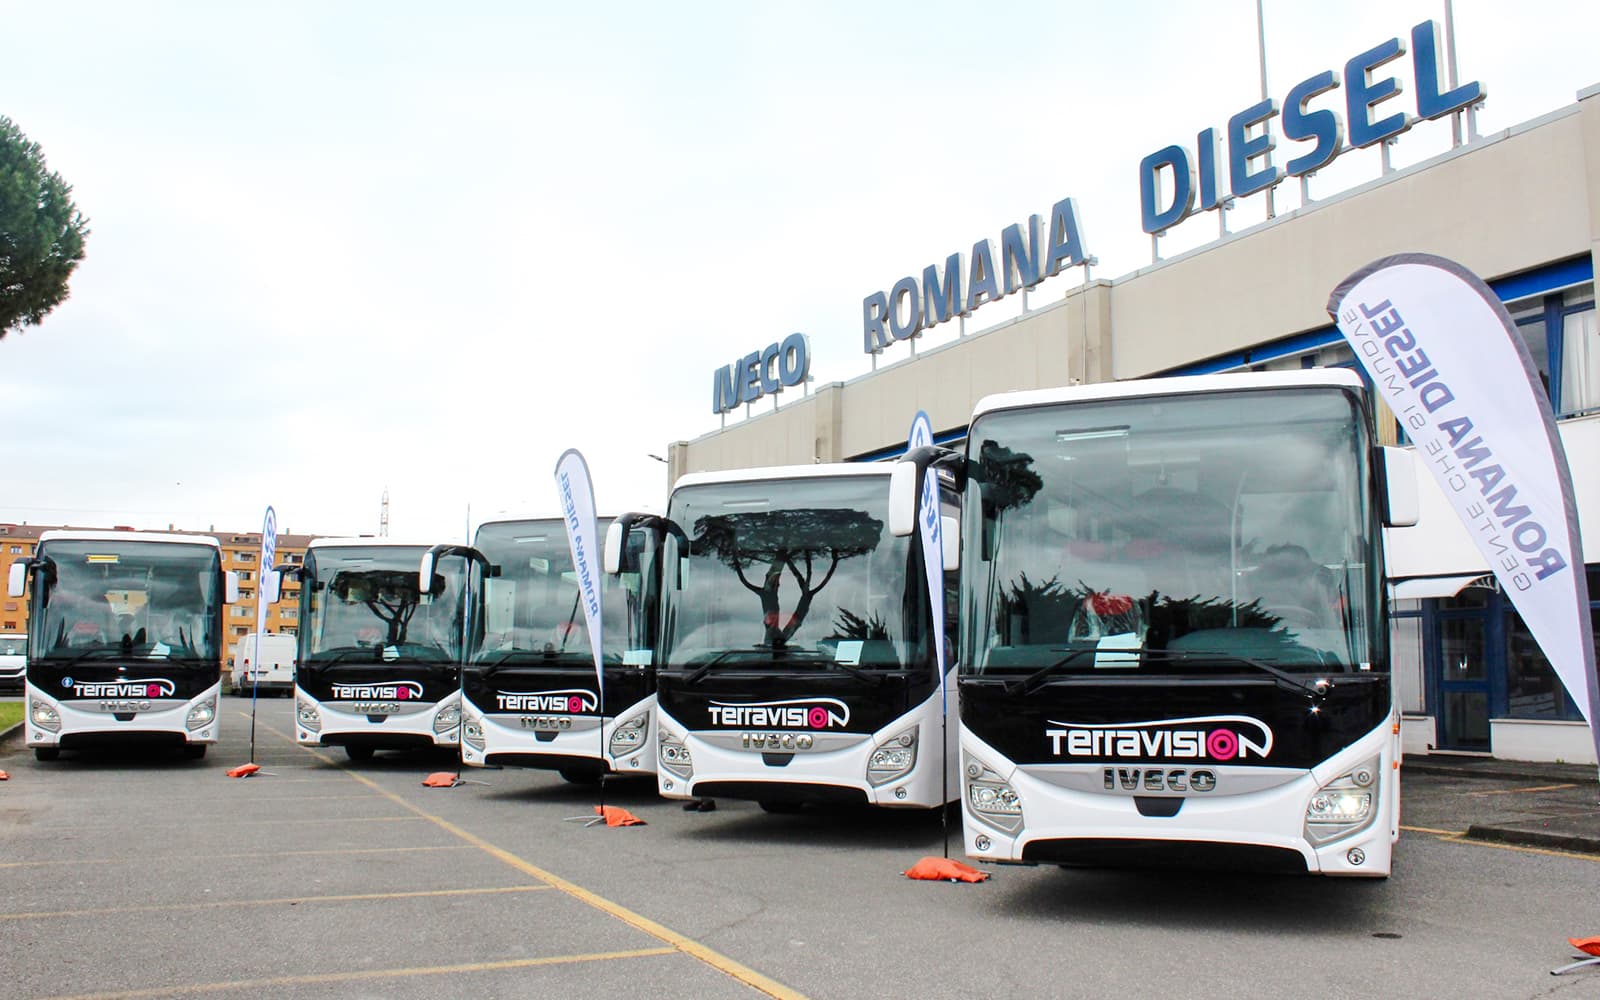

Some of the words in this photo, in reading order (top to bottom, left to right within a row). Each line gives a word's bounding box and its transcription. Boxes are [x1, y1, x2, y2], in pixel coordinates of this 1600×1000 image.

[712, 332, 811, 415] IVECO
[863, 197, 1090, 354] ROMANA
[1140, 19, 1488, 235] DIESEL
[100, 701, 151, 711] IVECO
[354, 702, 400, 712] IVECO
[521, 715, 572, 729] IVECO
[742, 732, 813, 749] IVECO
[1104, 767, 1217, 792] IVECO
